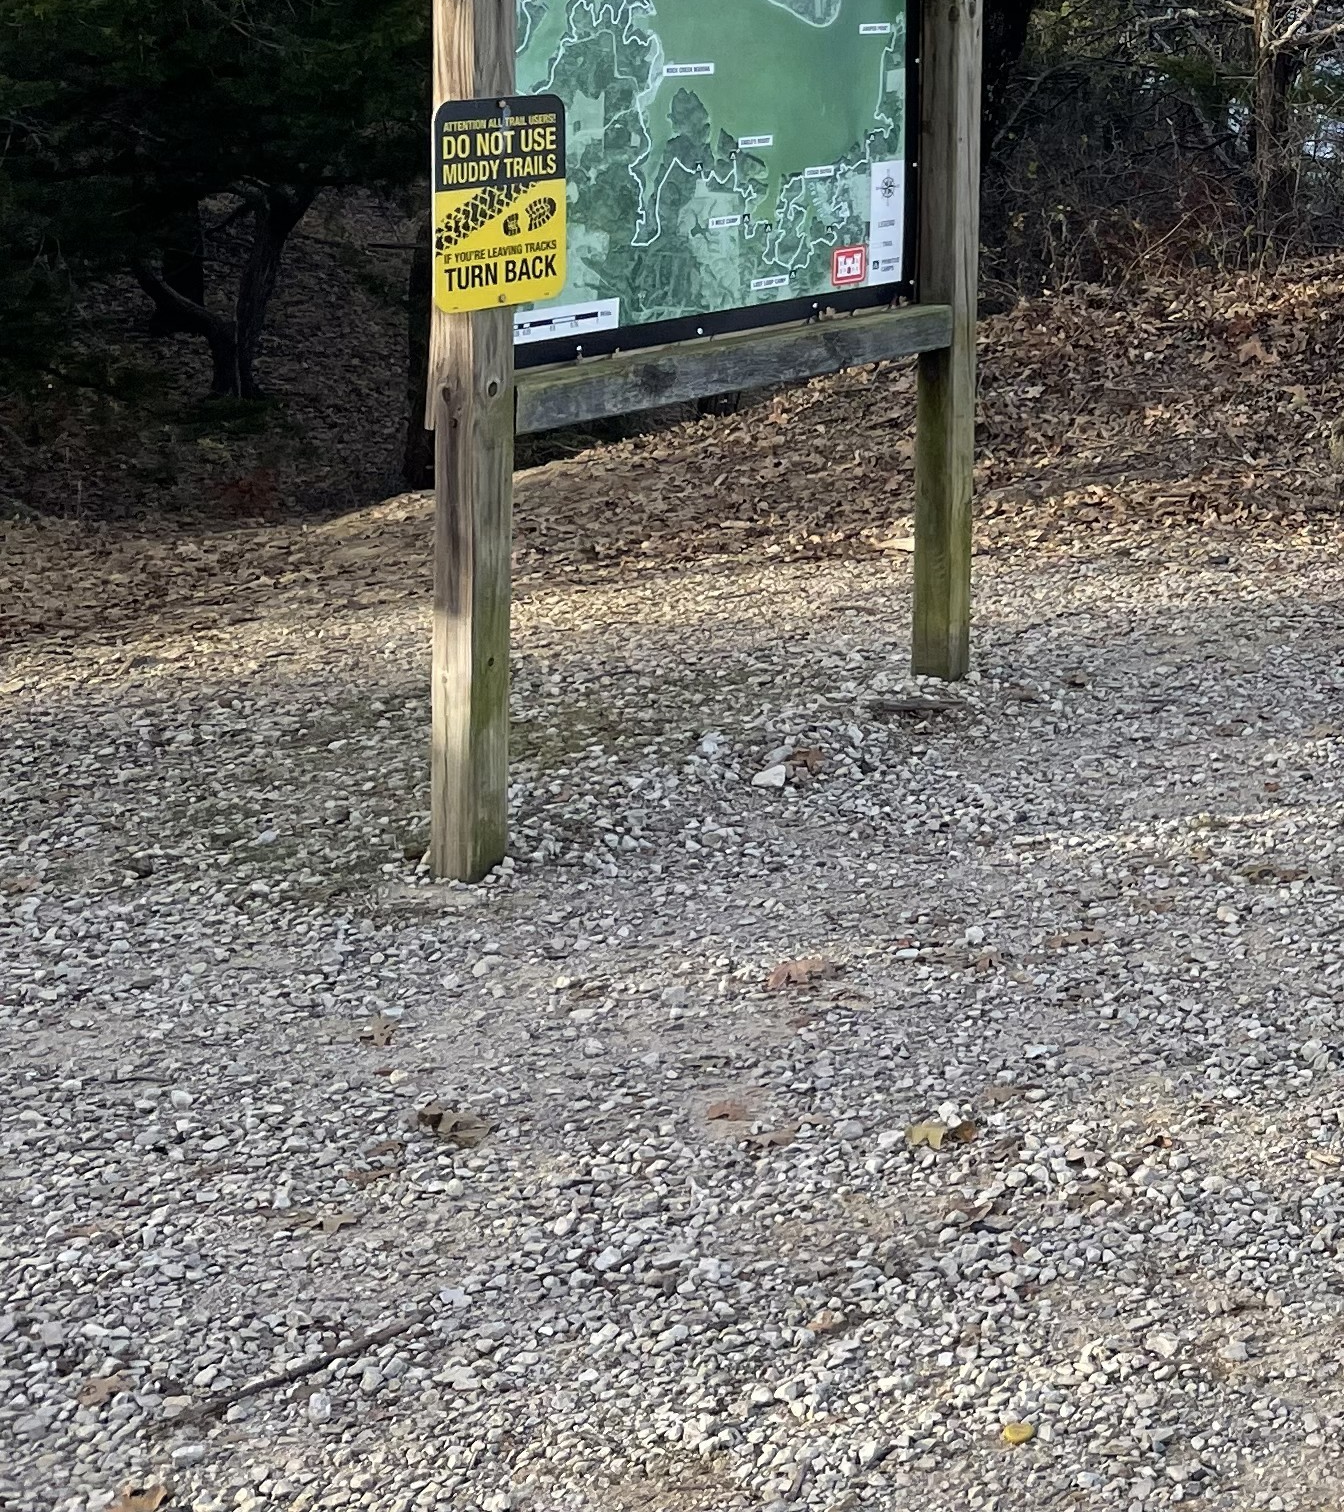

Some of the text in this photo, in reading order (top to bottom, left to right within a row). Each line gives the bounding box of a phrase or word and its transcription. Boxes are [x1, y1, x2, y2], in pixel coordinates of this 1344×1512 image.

[443, 113, 557, 132] ATTENTION ALL TRAIL USERS!
[442, 127, 557, 160] DO NOT USE
[442, 153, 557, 185] MUDDY TRAILS
[444, 239, 557, 264] IF YOU'RE LEAVING TRACKS
[444, 254, 557, 292] TURN BACK
